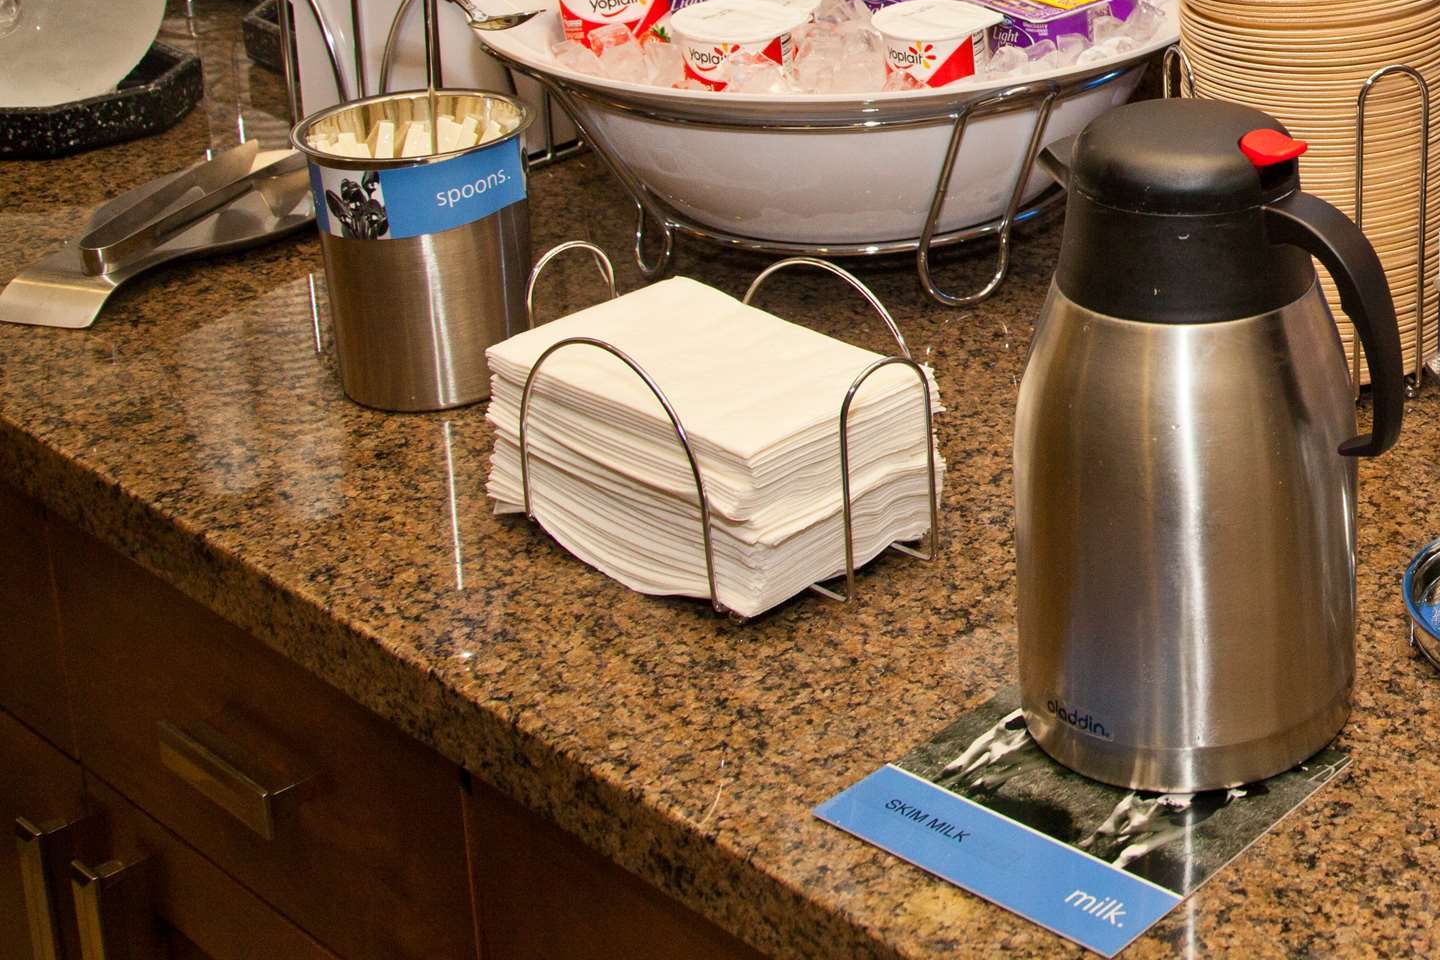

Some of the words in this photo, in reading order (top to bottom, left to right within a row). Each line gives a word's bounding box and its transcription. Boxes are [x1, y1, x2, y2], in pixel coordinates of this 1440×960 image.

[688, 47, 727, 66] Yopla
[436, 169, 511, 208] spoons.
[885, 799, 928, 824] SKIM
[926, 818, 971, 843] MILK
[1064, 890, 1127, 928] milk.
